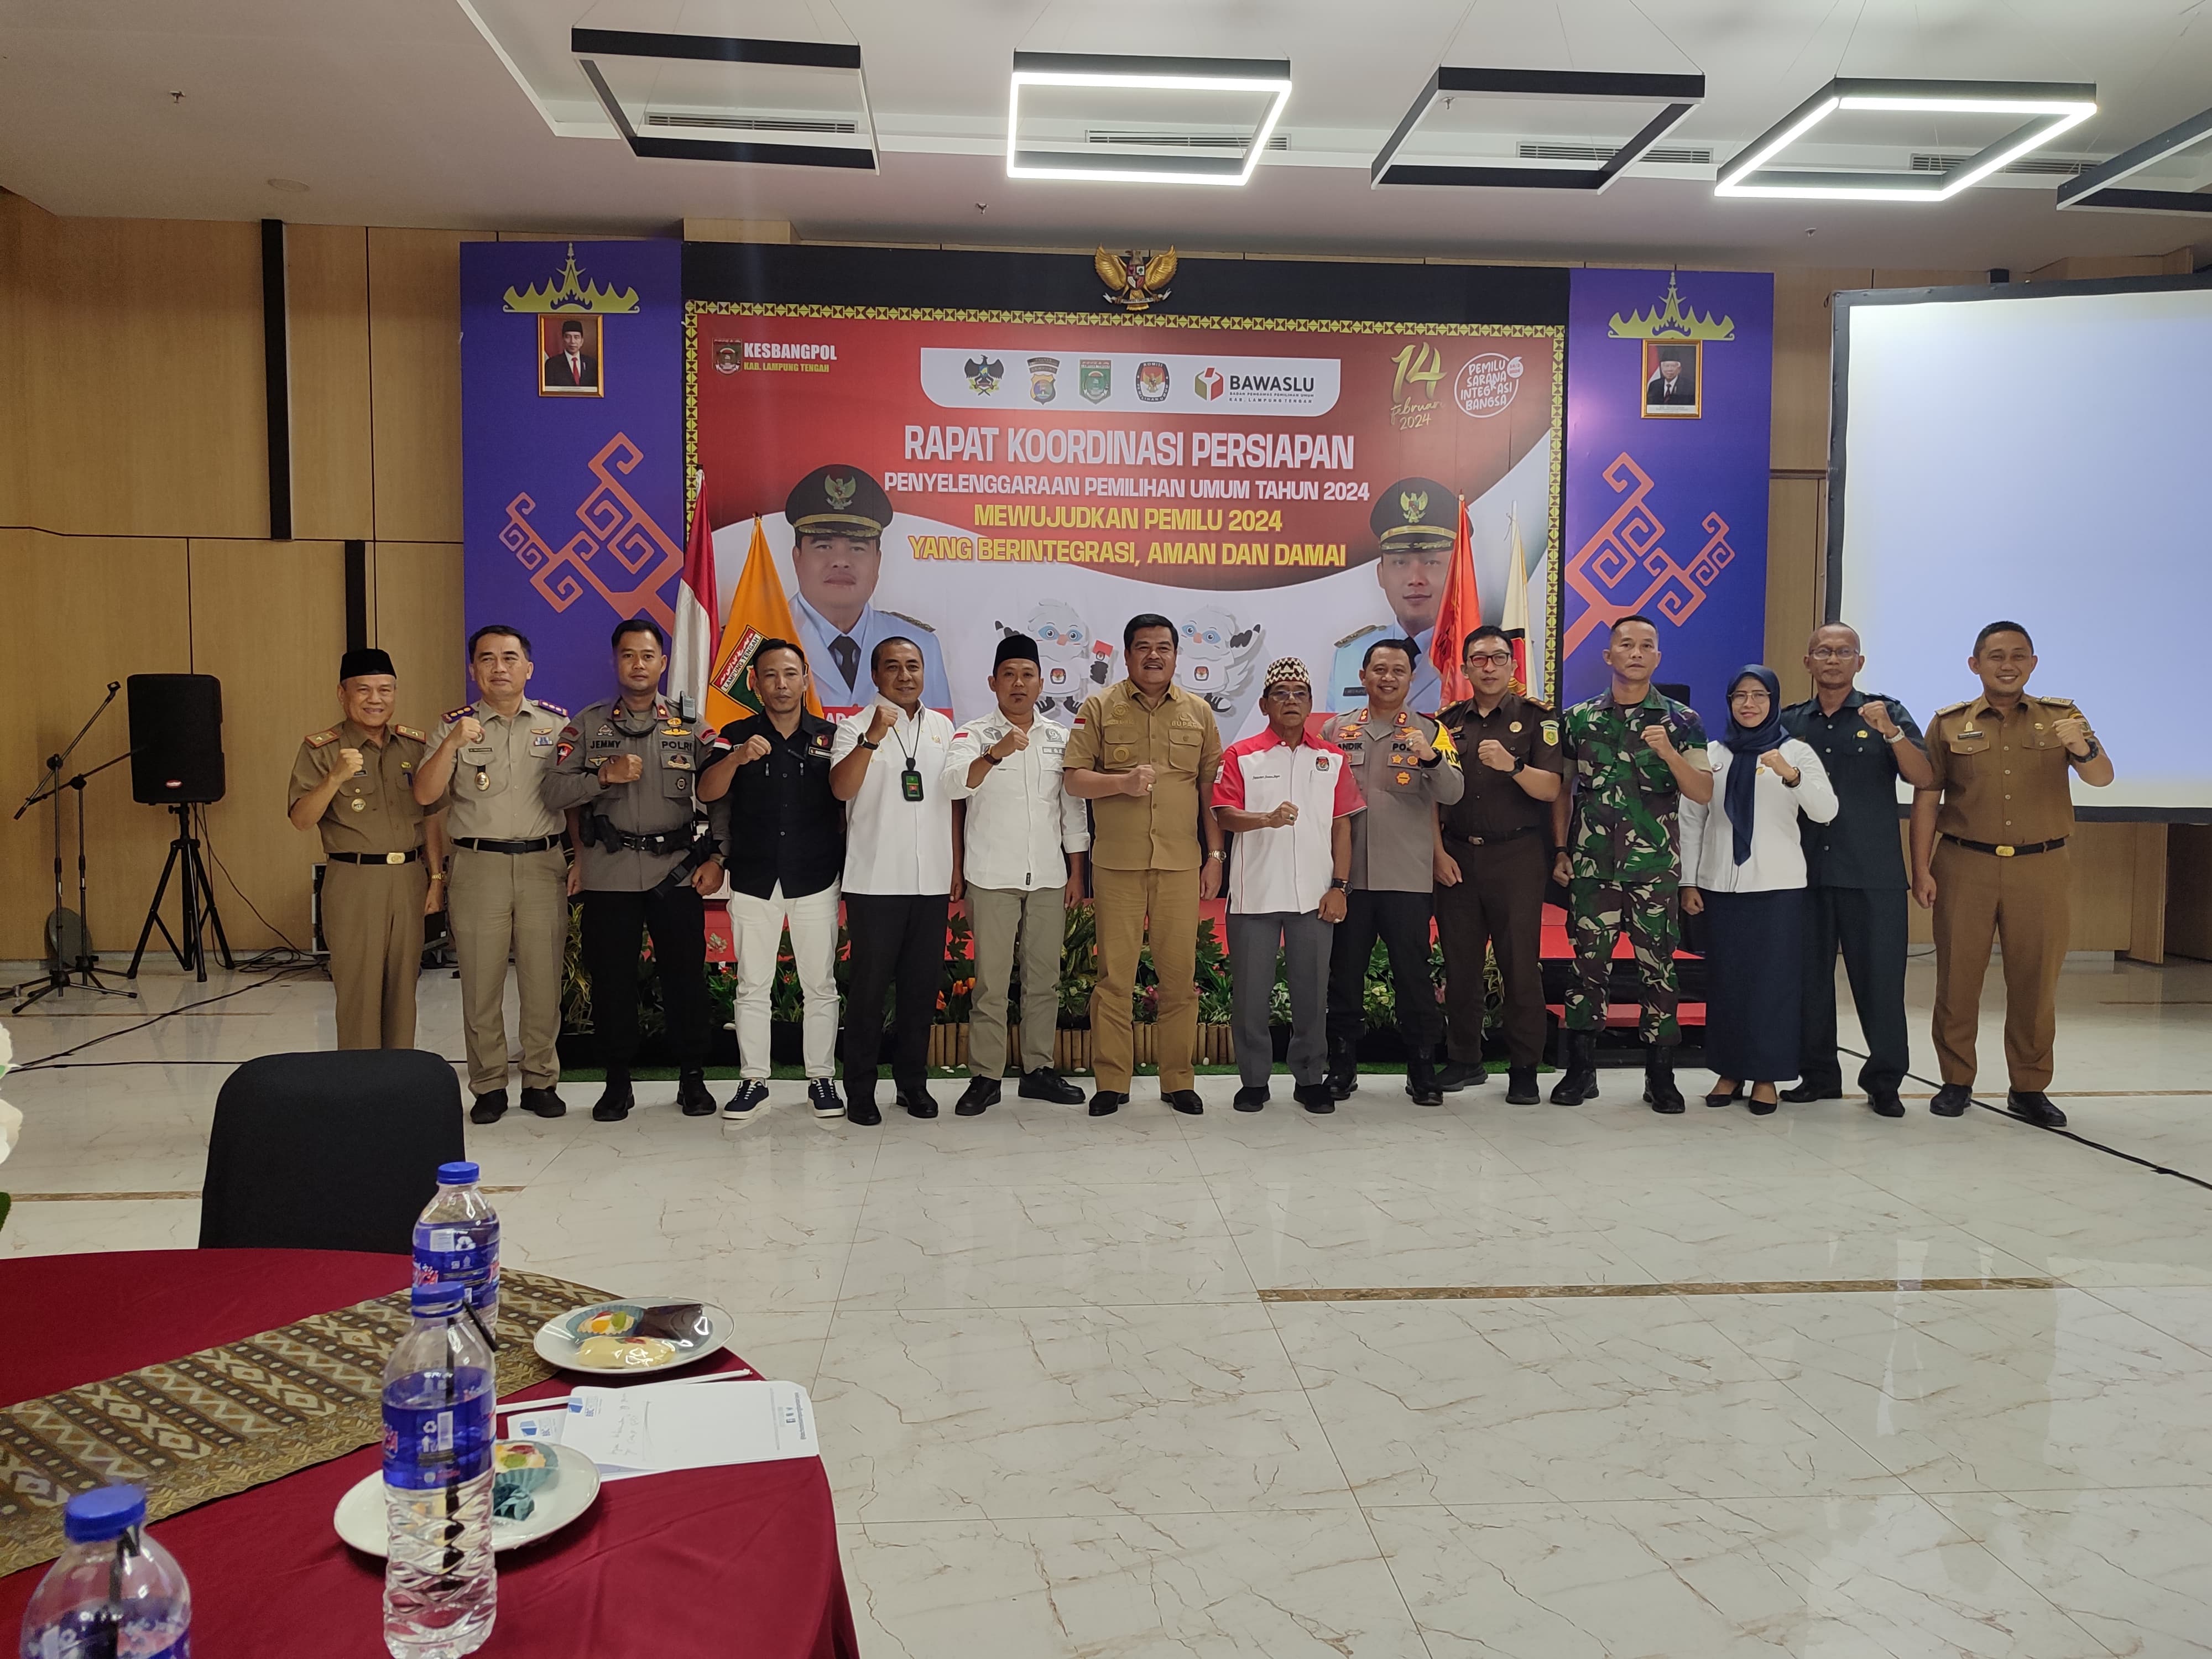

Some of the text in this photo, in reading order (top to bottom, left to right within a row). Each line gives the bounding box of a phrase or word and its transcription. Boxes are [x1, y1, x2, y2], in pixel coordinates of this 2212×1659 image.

[744, 343, 837, 360] KESBANGPOL
[763, 363, 799, 371] LAMPUNG
[800, 364, 830, 372] TENGAH
[1391, 342, 1447, 404] 14
[1468, 359, 1506, 376] PEMILU
[1229, 375, 1314, 392] BAWASLU
[1467, 370, 1507, 388] SARANA
[1465, 394, 1507, 411] BANGSA
[1400, 413, 1432, 430] 2024
[905, 425, 1354, 469] RAPAT KOORDINASI PERSIAPAN
[884, 472, 1370, 501] PENYELENGGARAAN PEMILIHAN UMUM TAHUN 2024
[974, 504, 1282, 531] MEWUJUDKAN PEMILU 2024
[908, 535, 1347, 567] YANG BERINTEGRASI, AMAN DAN DAMAI
[723, 661, 744, 690] LAMPUNG
[742, 637, 759, 662] TENGAH
[590, 740, 620, 749] JEMMY
[661, 741, 692, 751] POLRI
